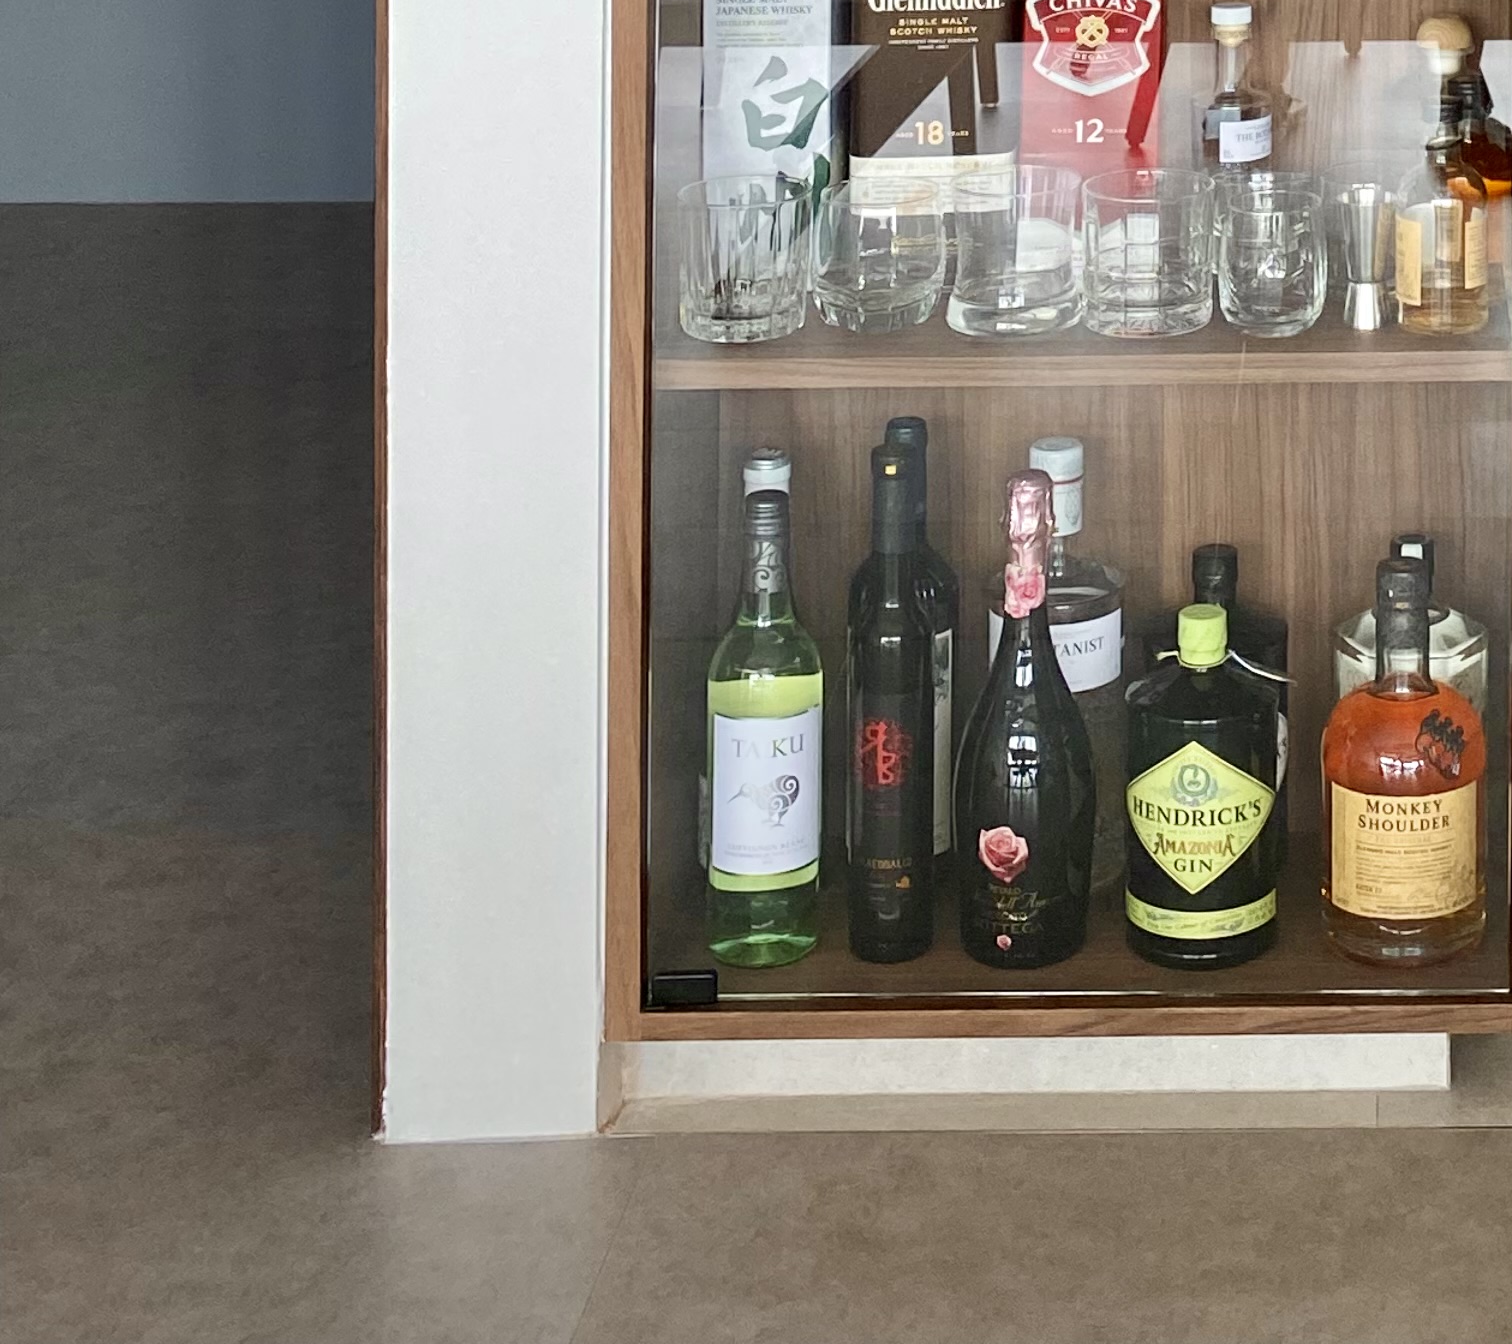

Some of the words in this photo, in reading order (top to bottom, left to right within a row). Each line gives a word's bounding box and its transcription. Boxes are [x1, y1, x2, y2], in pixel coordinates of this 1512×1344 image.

[716, 6, 769, 16] JAPANESE
[770, 5, 814, 15] WHISKY
[898, 17, 938, 26] SINGLE
[941, 16, 969, 25] MALT
[889, 26, 933, 36] SCOTCH
[937, 25, 978, 35] WHISKY
[1074, 52, 1109, 61] REGAL
[914, 120, 945, 145] 18
[1074, 118, 1105, 144] 12
[1133, 795, 1262, 827] HENDRICK'S
[1366, 798, 1442, 816] MONKEY
[1358, 814, 1450, 832] SHOULDER
[1153, 832, 1237, 857] AMAZONIA
[1173, 858, 1214, 873] GIN
